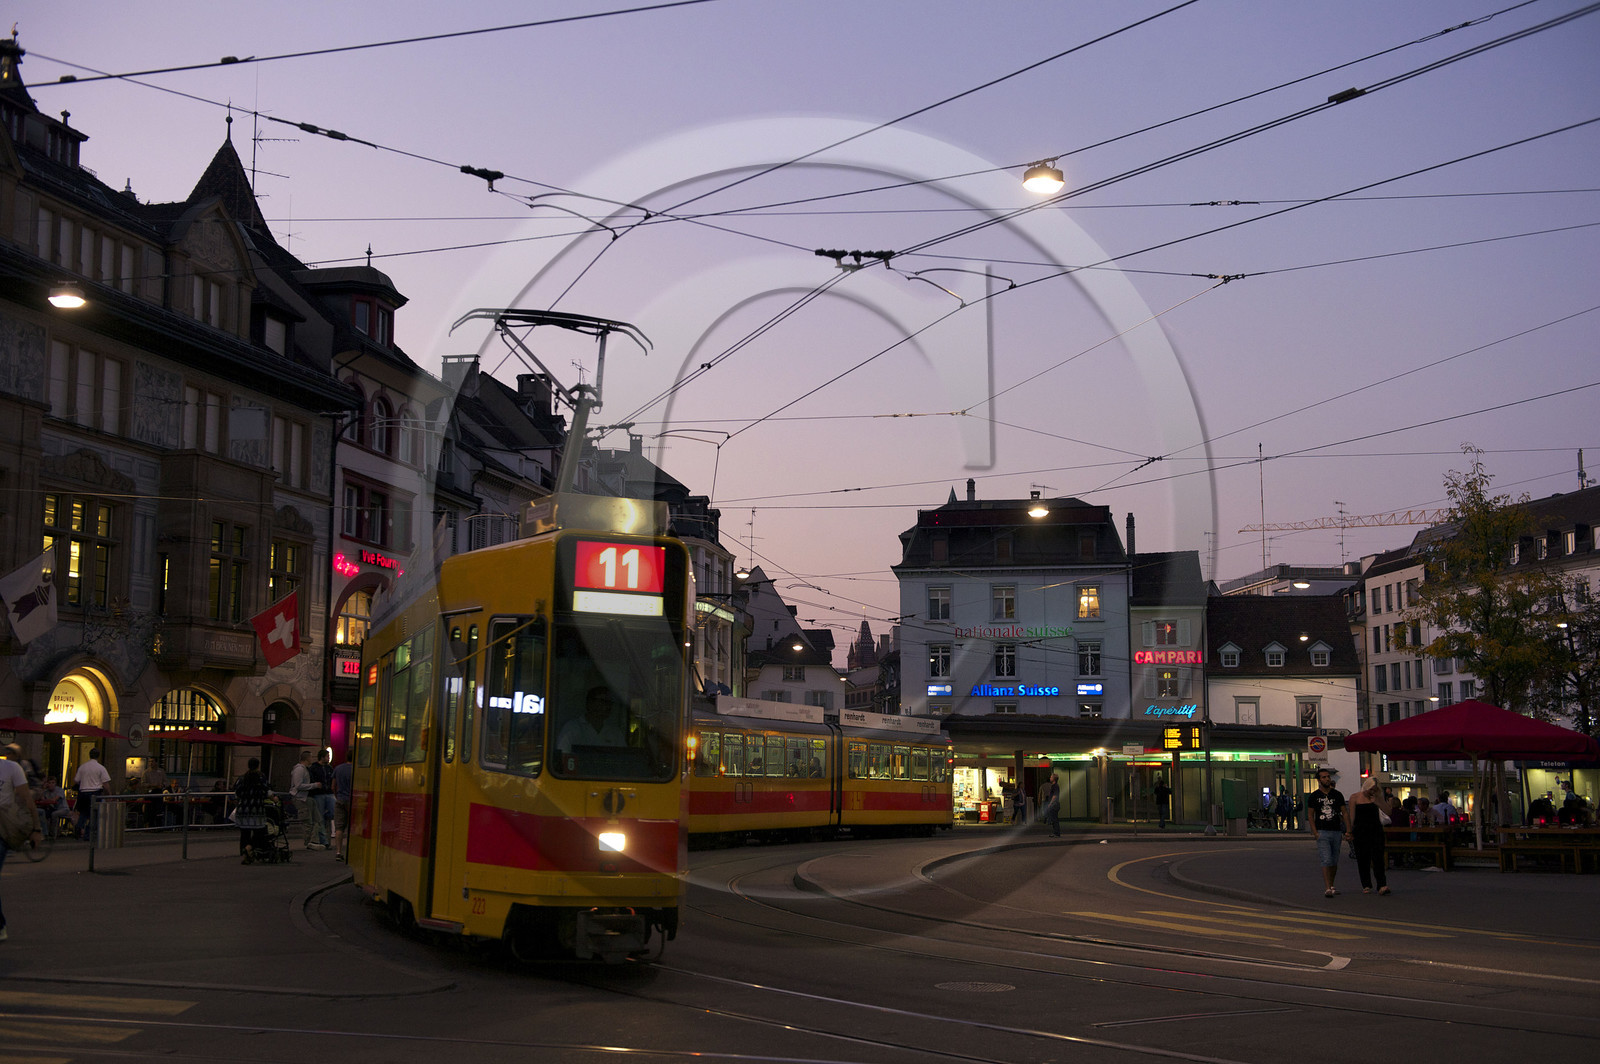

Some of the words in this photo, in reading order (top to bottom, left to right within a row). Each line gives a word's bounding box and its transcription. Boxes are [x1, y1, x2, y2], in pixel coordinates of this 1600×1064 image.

[599, 547, 640, 589] 11
[955, 625, 1024, 638] nationale
[1026, 624, 1073, 637] suisse
[1134, 650, 1203, 664] CAMPARI
[970, 684, 1015, 697] Allianz
[1017, 684, 1059, 697] Suisse
[53, 703, 74, 713] MUTZ
[1144, 704, 1197, 719] l'apéritif
